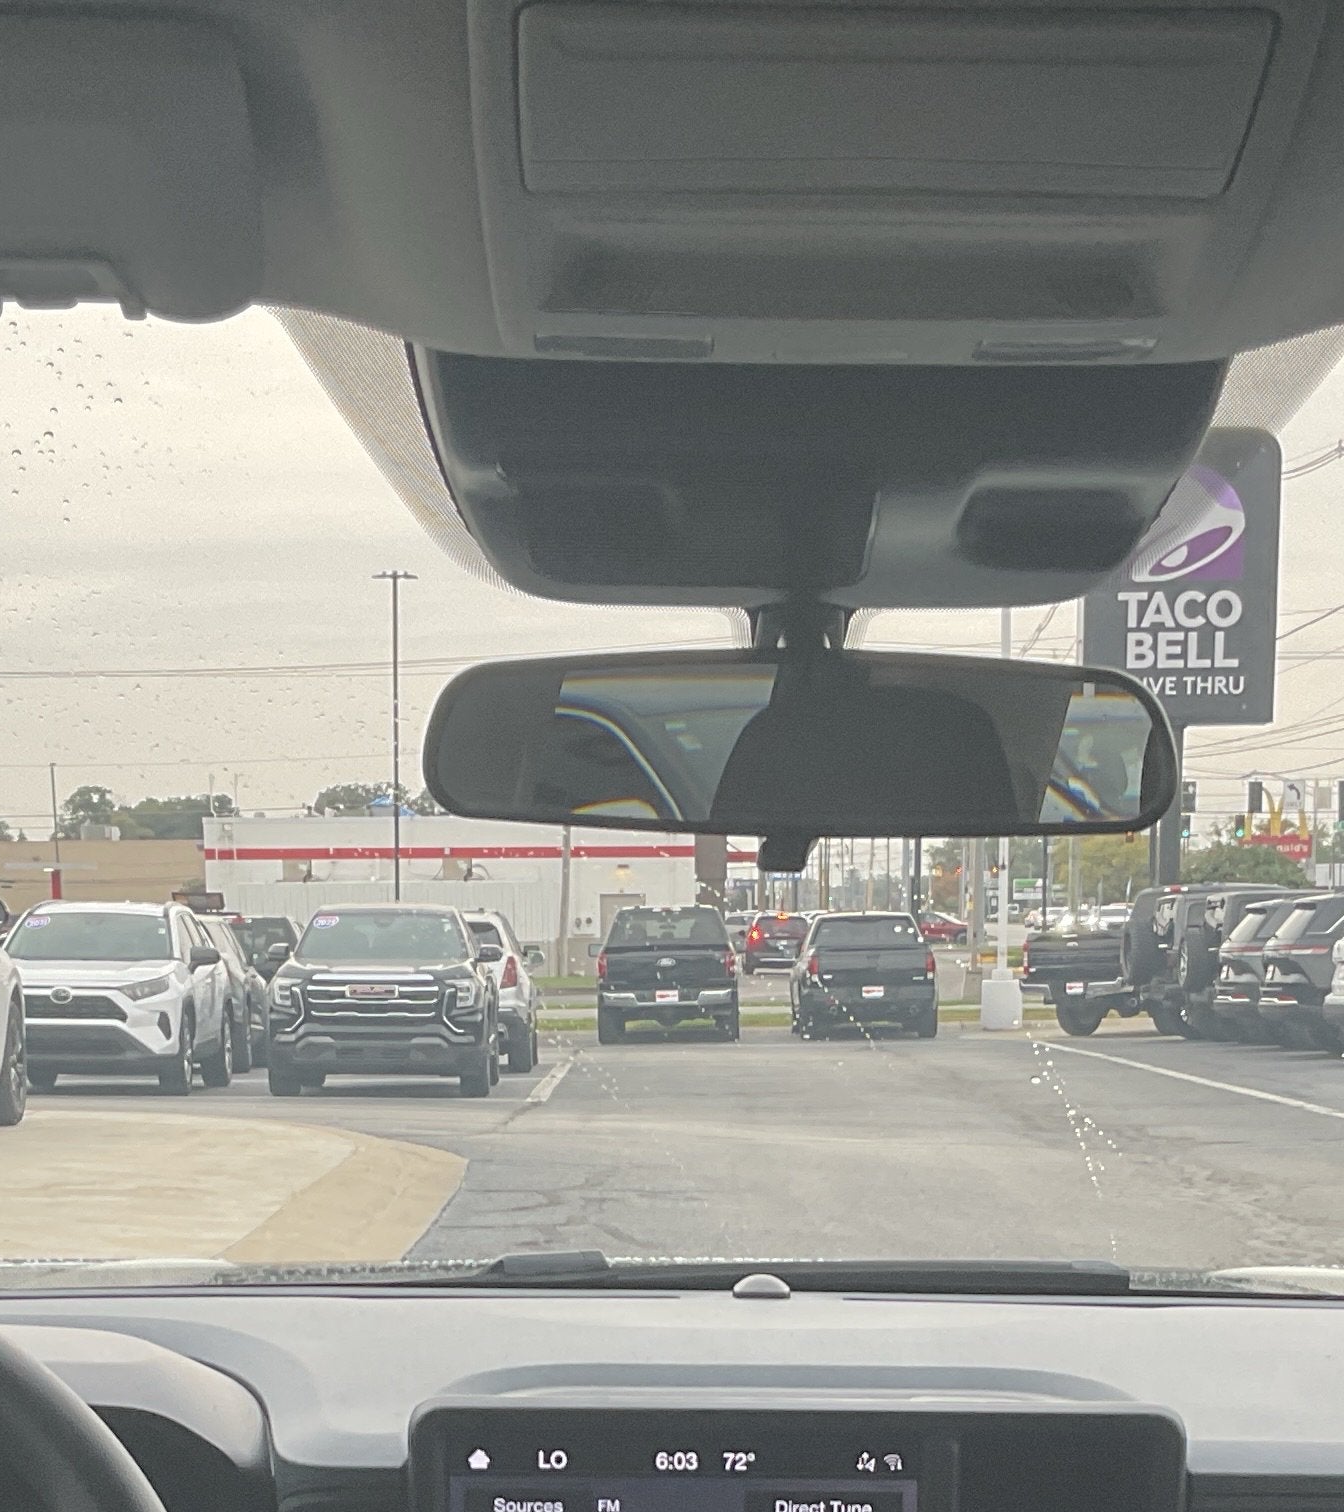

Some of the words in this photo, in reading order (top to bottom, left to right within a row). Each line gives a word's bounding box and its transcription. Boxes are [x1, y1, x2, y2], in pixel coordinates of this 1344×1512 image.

[1117, 590, 1243, 628] TACO
[1126, 631, 1239, 669] BELL
[1142, 676, 1177, 695] IVE
[1183, 675, 1245, 695] THRU
[538, 1449, 568, 1470] LO
[655, 1451, 698, 1471] 6:03
[723, 1451, 756, 1471] 72°
[597, 1499, 620, 1512] FM
